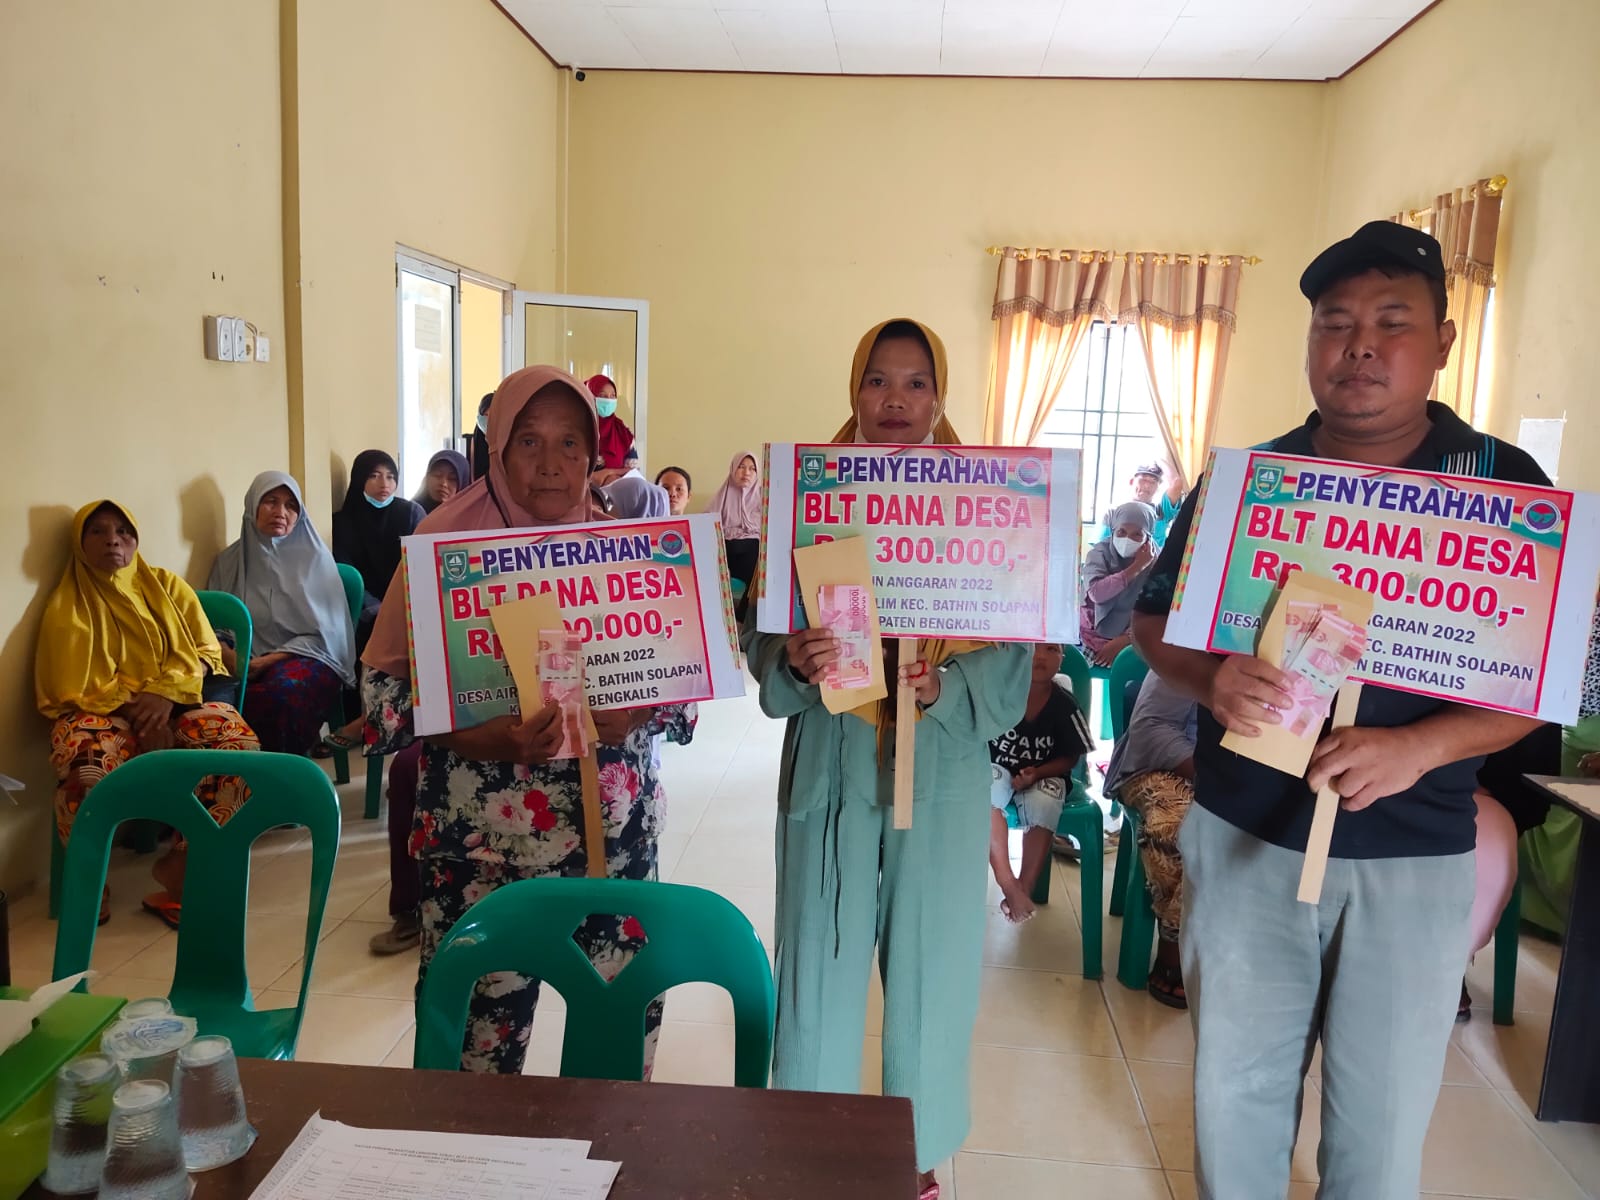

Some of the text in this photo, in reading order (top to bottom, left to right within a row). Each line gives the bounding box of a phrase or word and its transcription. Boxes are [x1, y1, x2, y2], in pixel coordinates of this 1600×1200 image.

[837, 456, 1008, 485] PENYERAHAN
[804, 493, 1033, 529] BLT DANA DESA
[1296, 472, 1513, 527] PENYERAHAN
[482, 535, 650, 574] PENYERAHAN
[876, 536, 1028, 572] 300.000,-
[1247, 506, 1538, 581] BLT DANA DESA
[451, 584, 507, 620] BLT
[607, 567, 683, 603] DESA
[887, 576, 957, 590] ANGGARAN
[960, 578, 993, 591] 2022
[875, 598, 1040, 614] LIM KEC. BATHIN SOLAPAN
[919, 617, 991, 631] BENGKALIS
[1432, 624, 1476, 644] 2022
[623, 648, 655, 663] 2022
[1222, 612, 1262, 630] DESA
[1391, 643, 1452, 666] BATHIN
[1456, 655, 1534, 681] SOLAPAN
[457, 690, 493, 705] DESA
[495, 686, 518, 700] AIR
[599, 670, 644, 688] BATHIN
[647, 663, 703, 681] SOLAPAN
[1372, 661, 1467, 691] BENGKALIS
[588, 687, 660, 707] BENGKALIS
[992, 737, 1051, 761] SELAL
